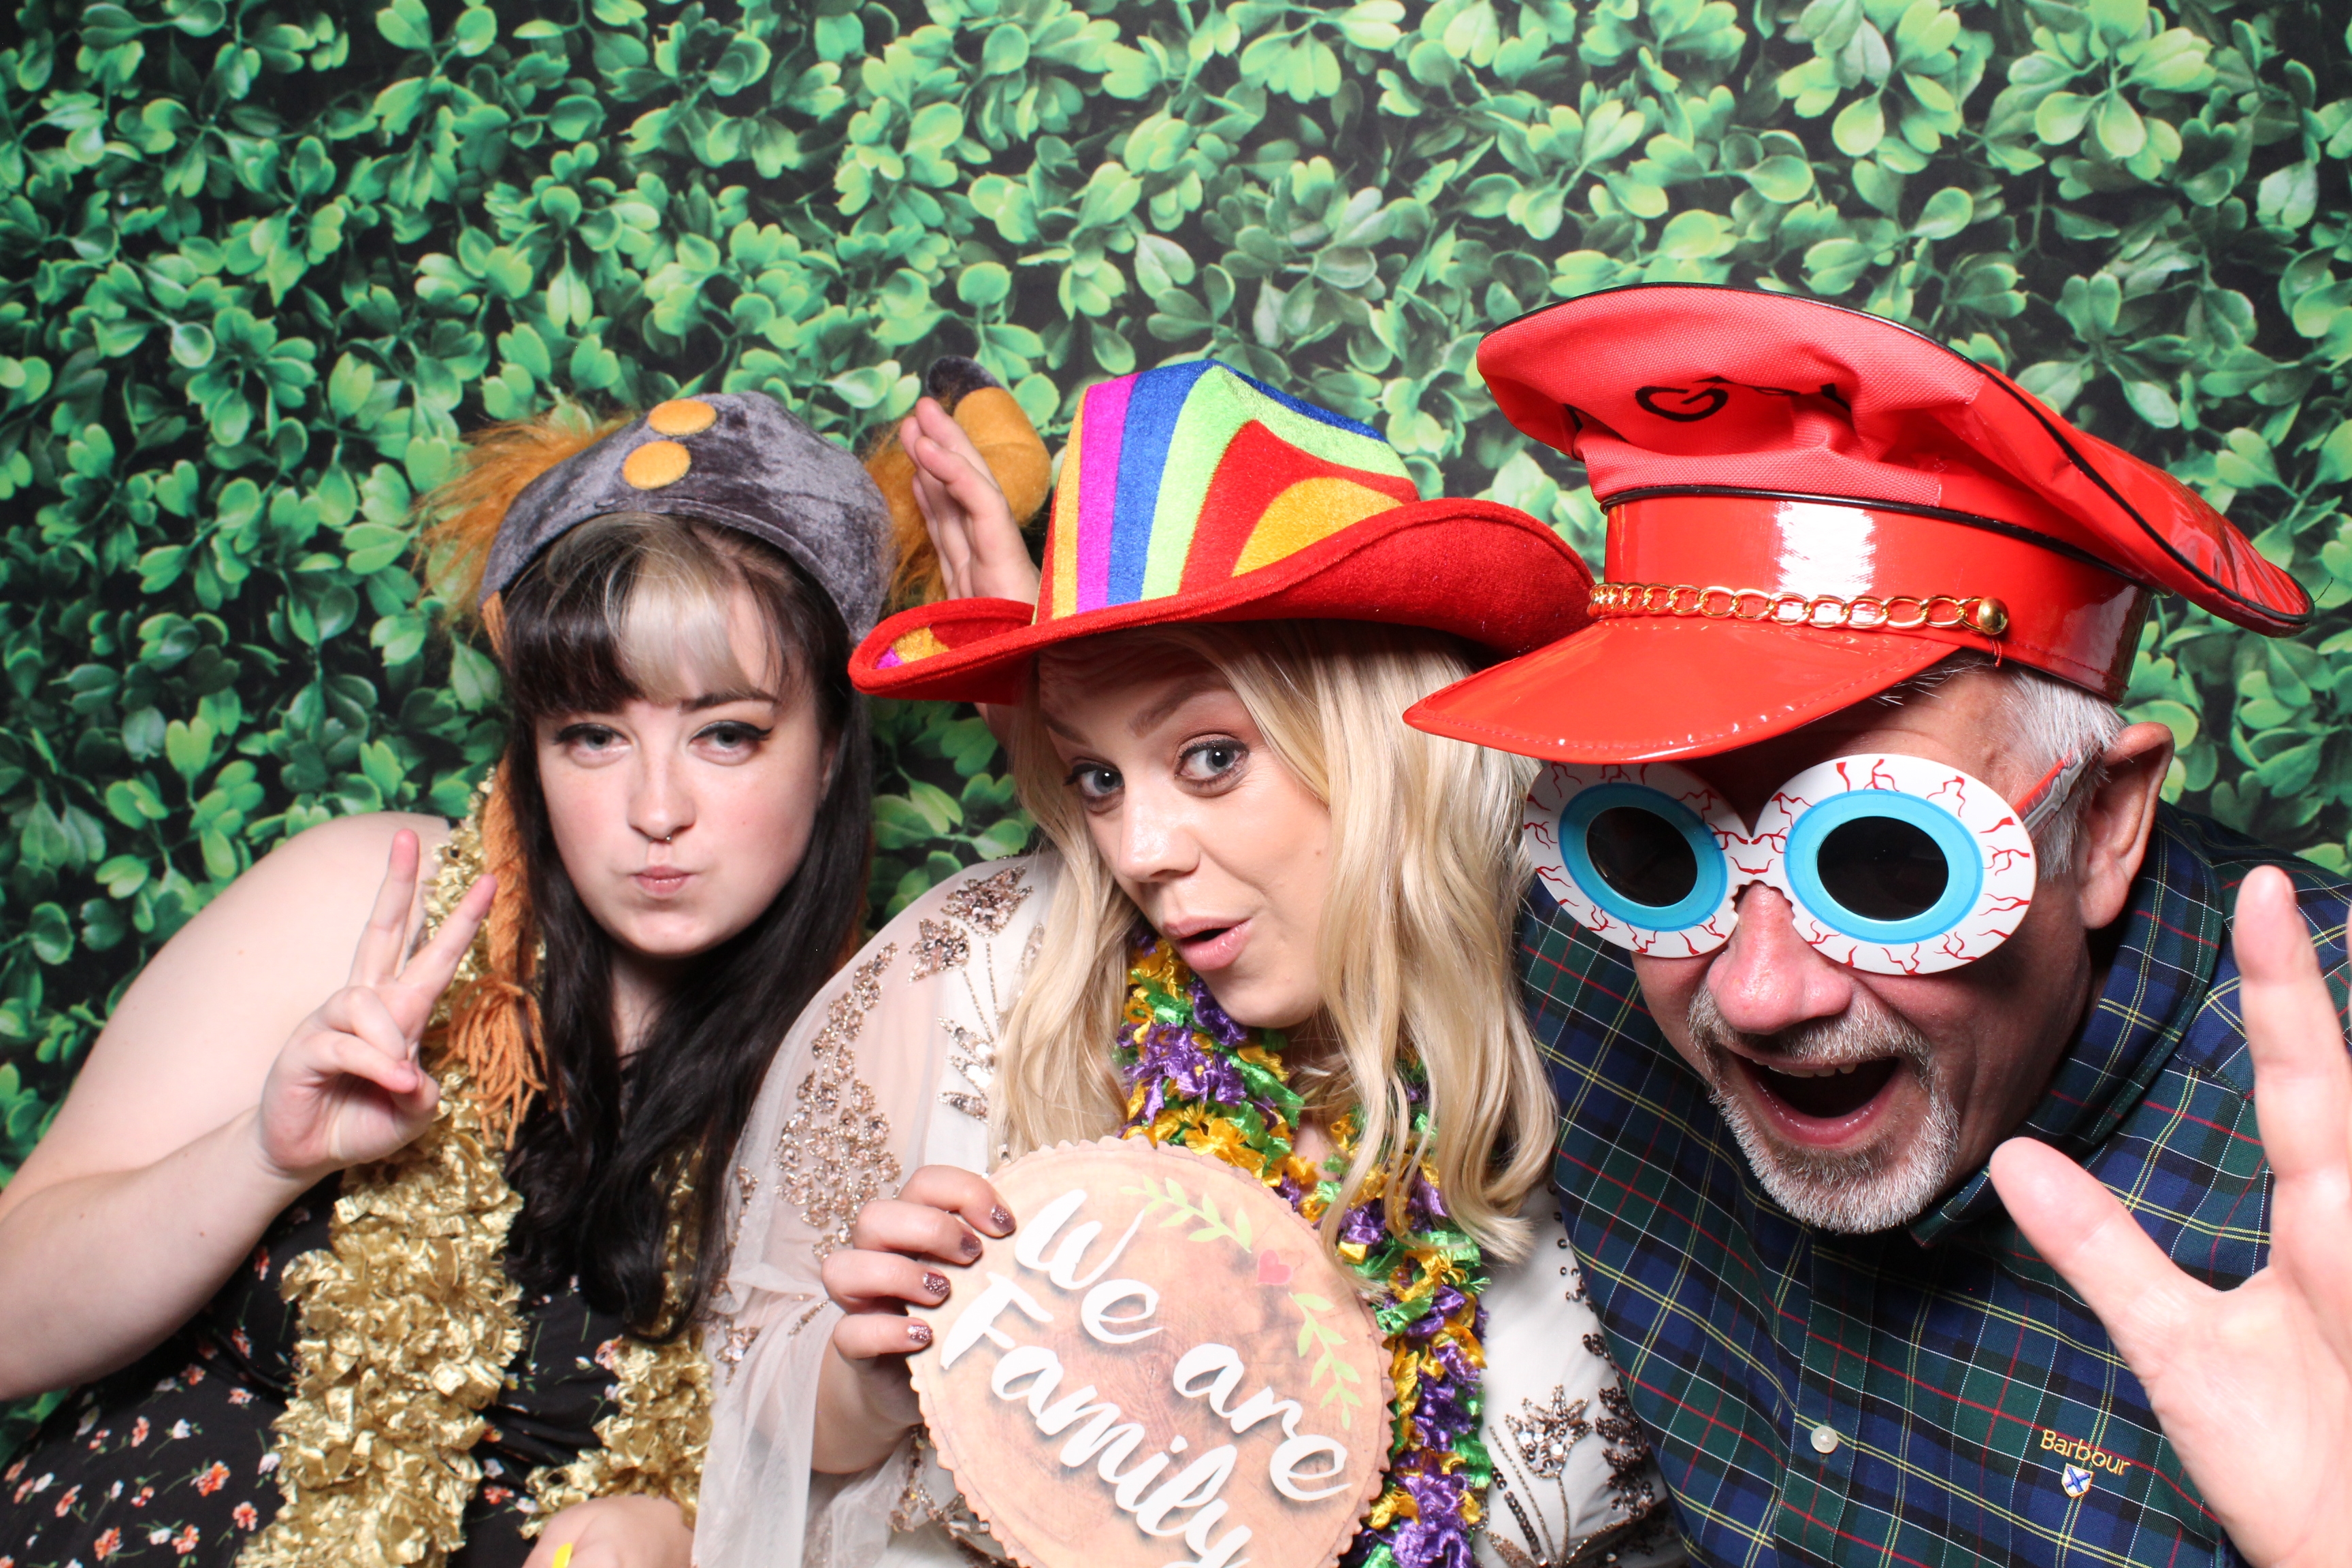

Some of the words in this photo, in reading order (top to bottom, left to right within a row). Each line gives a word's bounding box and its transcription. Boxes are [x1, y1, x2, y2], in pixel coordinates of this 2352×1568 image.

[940, 1272, 1252, 1568] Family
[1015, 1189, 1163, 1343] We
[1173, 1343, 1352, 1500] are
[2040, 1429, 2131, 1475] Barbour
